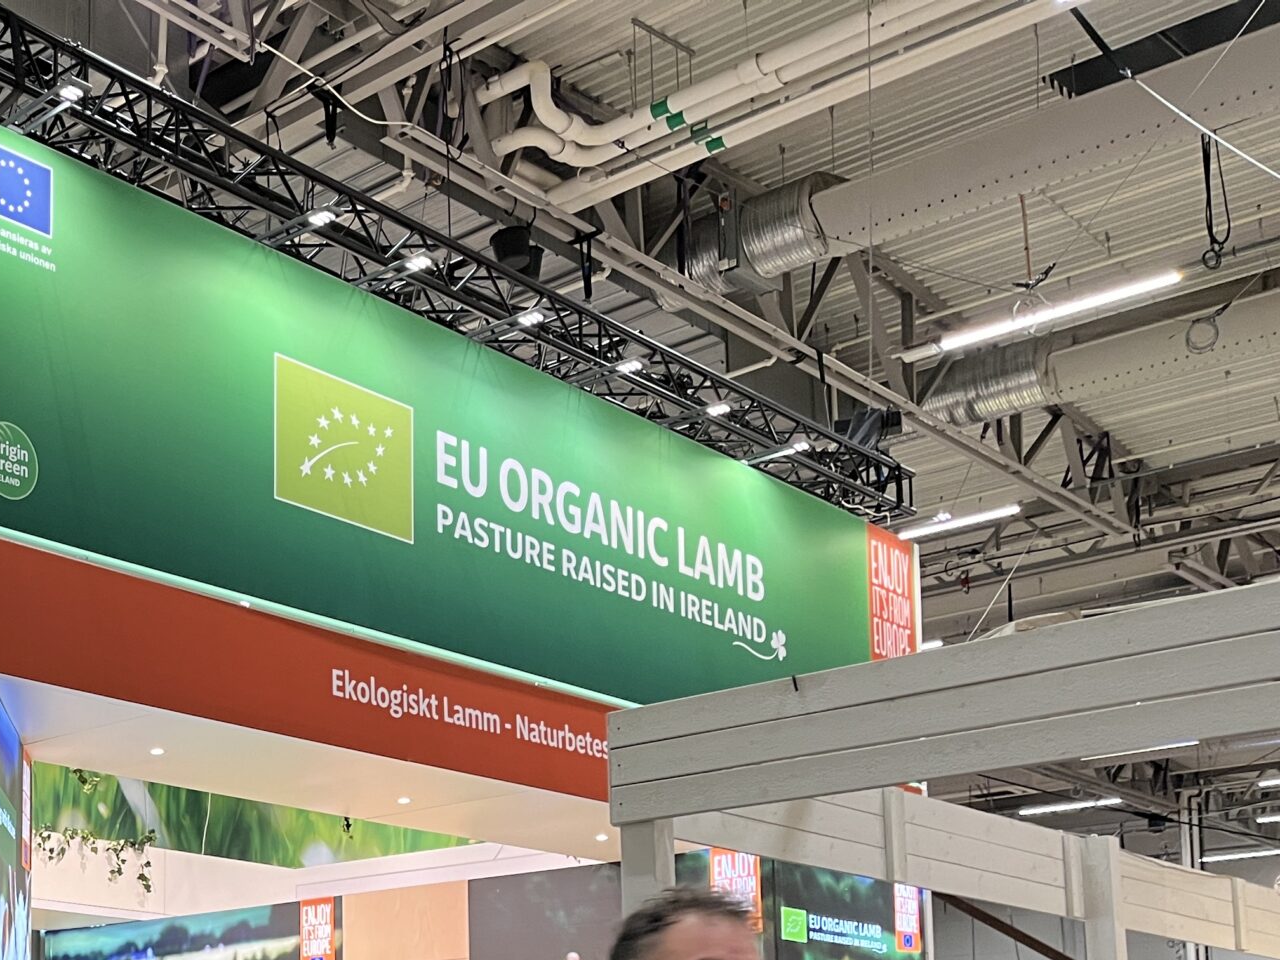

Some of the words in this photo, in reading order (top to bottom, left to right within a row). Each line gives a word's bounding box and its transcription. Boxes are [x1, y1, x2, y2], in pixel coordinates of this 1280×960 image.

[20, 251, 56, 272] unionen
[41, 245, 53, 255] av
[436, 430, 488, 498] EU
[499, 457, 669, 567] ORGANIC
[677, 526, 766, 602] LAMB
[436, 503, 555, 572] PASTURE
[562, 548, 647, 602] RAISED
[652, 581, 675, 613] IN
[680, 591, 767, 643] IRELAND
[870, 539, 909, 597] ENJOY
[872, 585, 888, 619] IT'S
[889, 592, 911, 628] FROM
[873, 617, 911, 658] EUROPE
[331, 668, 438, 720] Ekologiskt
[443, 696, 500, 734] Lamm
[713, 852, 755, 880] ENJOY
[303, 904, 331, 926] ENJOY
[808, 914, 820, 930] EU
[821, 916, 858, 935] ORGANIC
[859, 922, 882, 939] LAMB
[314, 924, 331, 940] FROM
[303, 938, 331, 957] EUROPE
